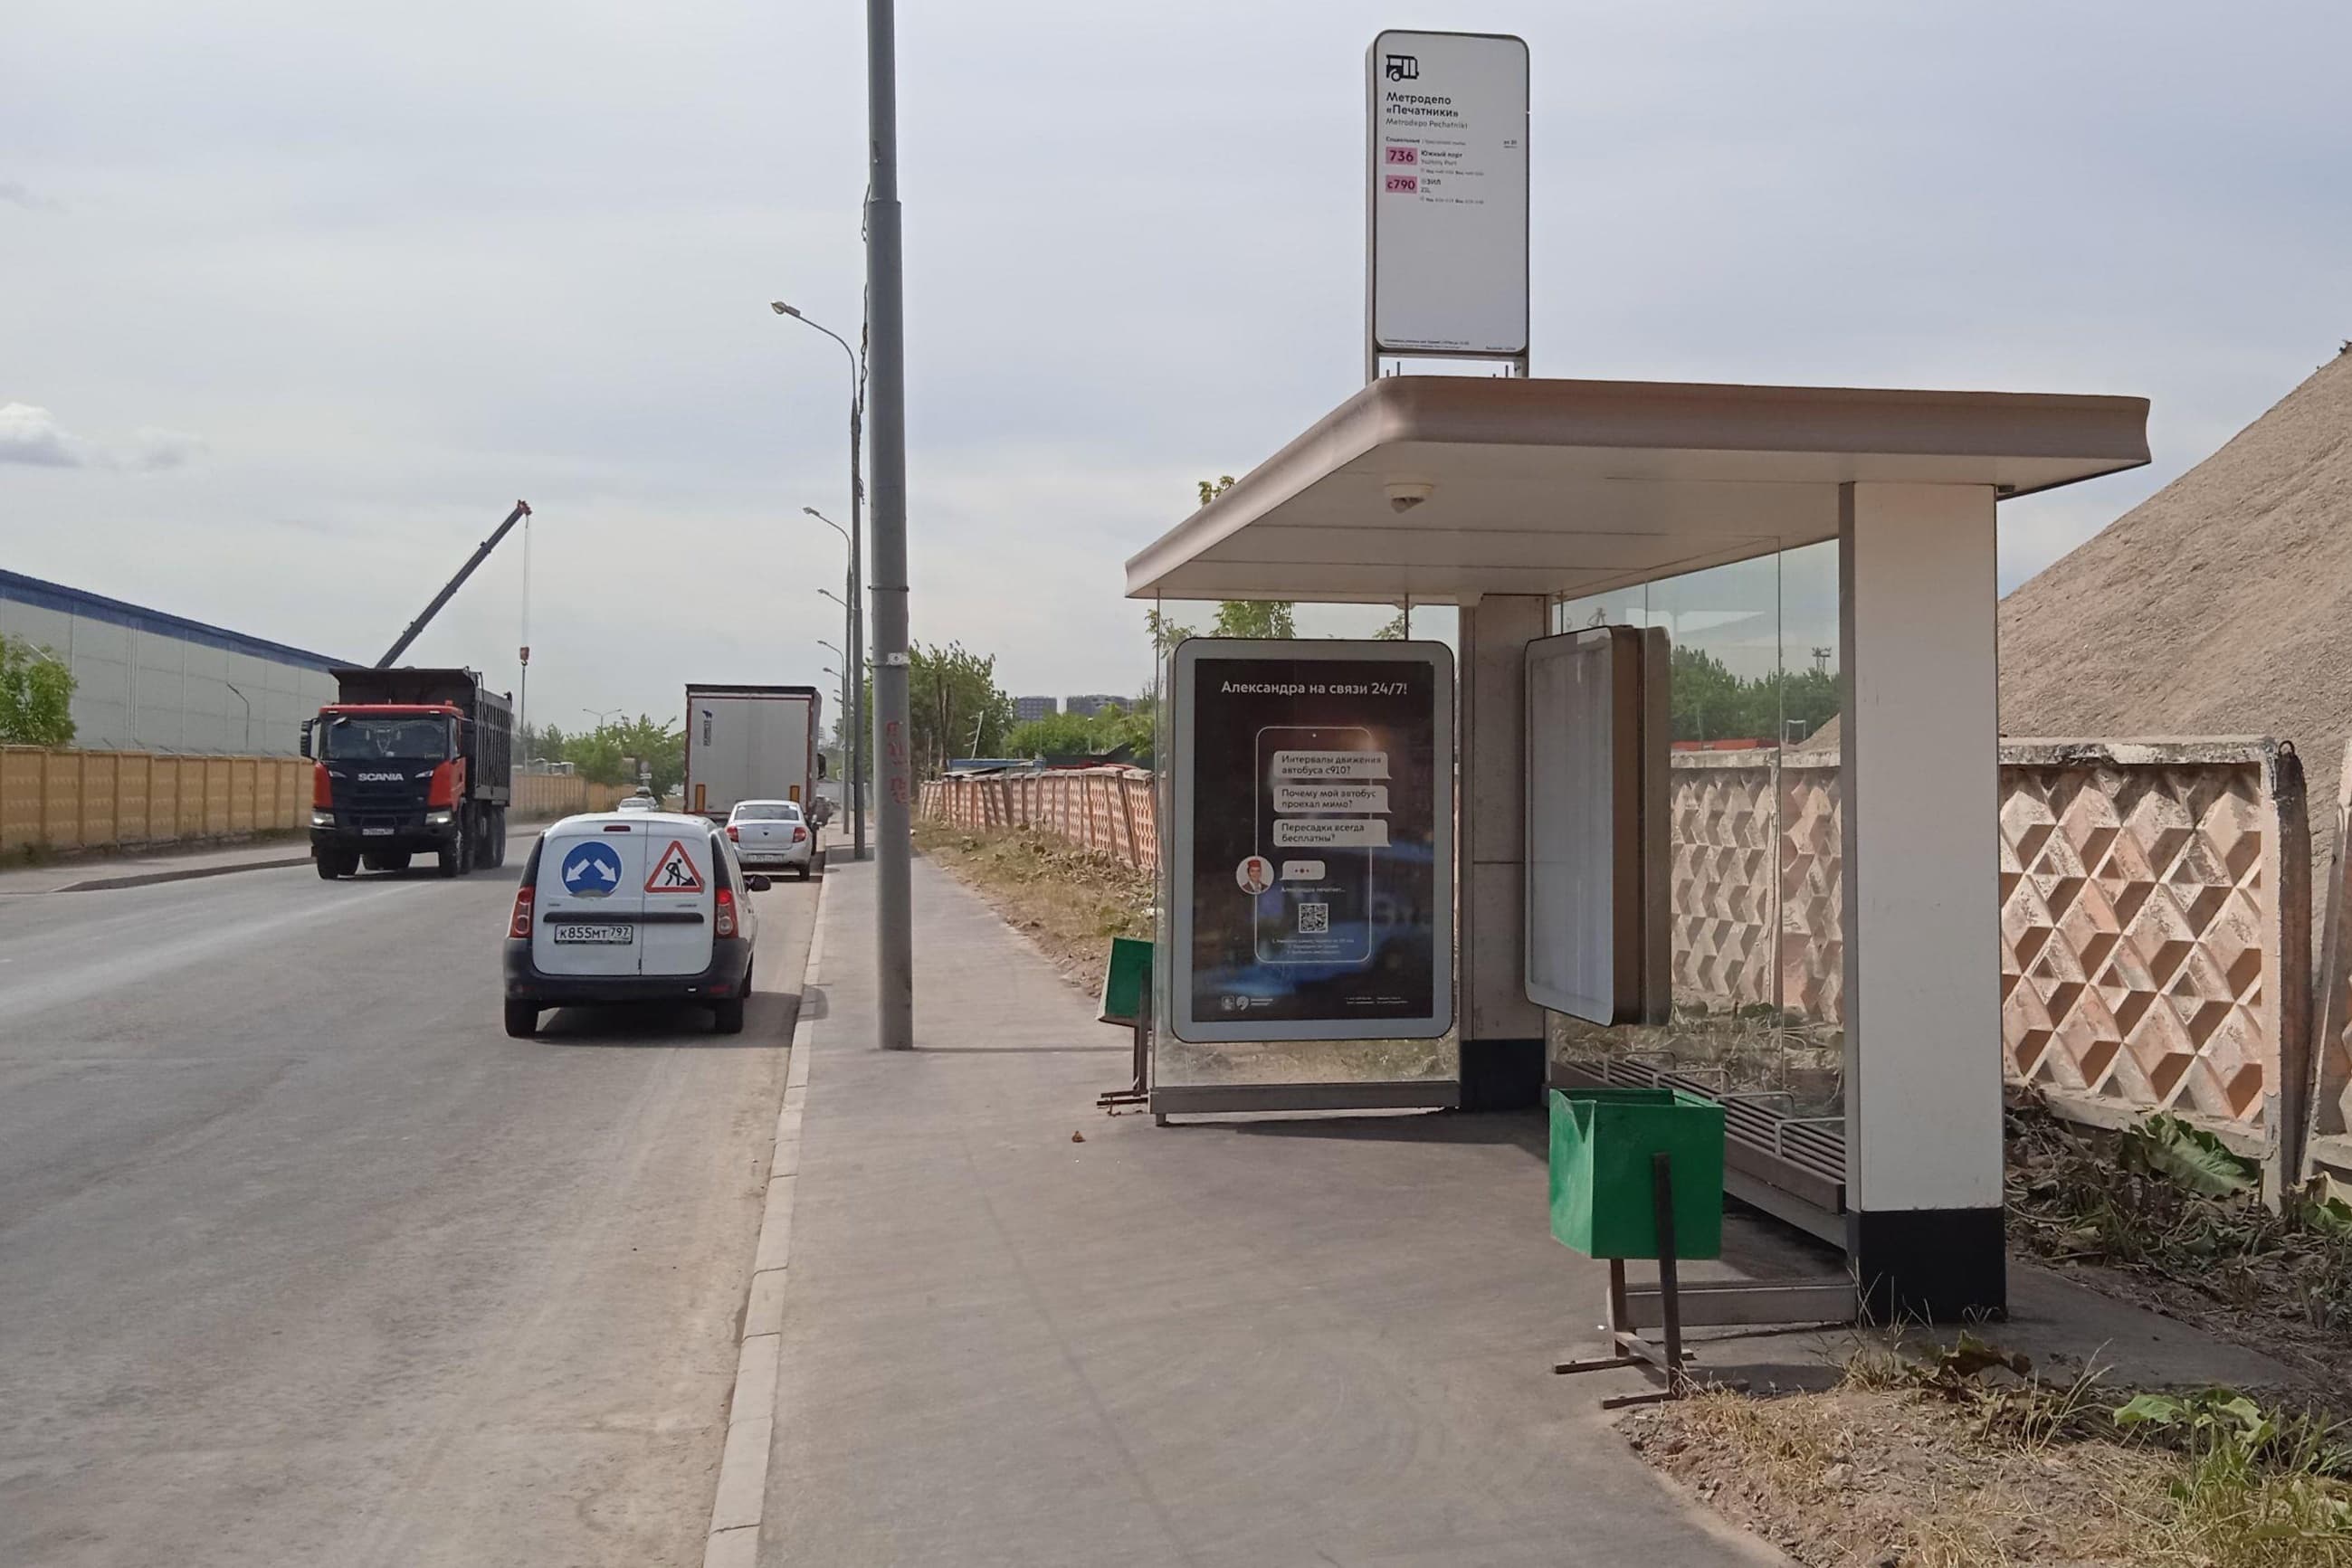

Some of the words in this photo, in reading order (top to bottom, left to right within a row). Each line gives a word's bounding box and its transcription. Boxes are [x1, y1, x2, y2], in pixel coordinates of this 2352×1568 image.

[1386, 91, 1452, 106] Метродепо
[1386, 104, 1459, 118] «Печатники»
[1385, 118, 1428, 128] Metrodepo
[1389, 149, 1414, 162] 736
[1221, 680, 1305, 696] Александра
[1309, 684, 1326, 694] на
[1329, 684, 1367, 695] связи
[1371, 683, 1408, 696] 24/7!
[1281, 755, 1334, 765] Интервалы
[1335, 756, 1382, 765] движения
[1281, 765, 1323, 775] автобуса
[357, 773, 405, 782] SCANIA
[1281, 788, 1318, 799] Почему
[1320, 789, 1338, 797] мой
[1341, 788, 1376, 799] автобус
[1281, 801, 1320, 810] проехал
[1322, 800, 1353, 808] мимо?
[1281, 822, 1332, 833] Пересадки
[1334, 824, 1365, 832] всегда
[1281, 832, 1336, 842] бесплатны?
[611, 927, 629, 937] 797
